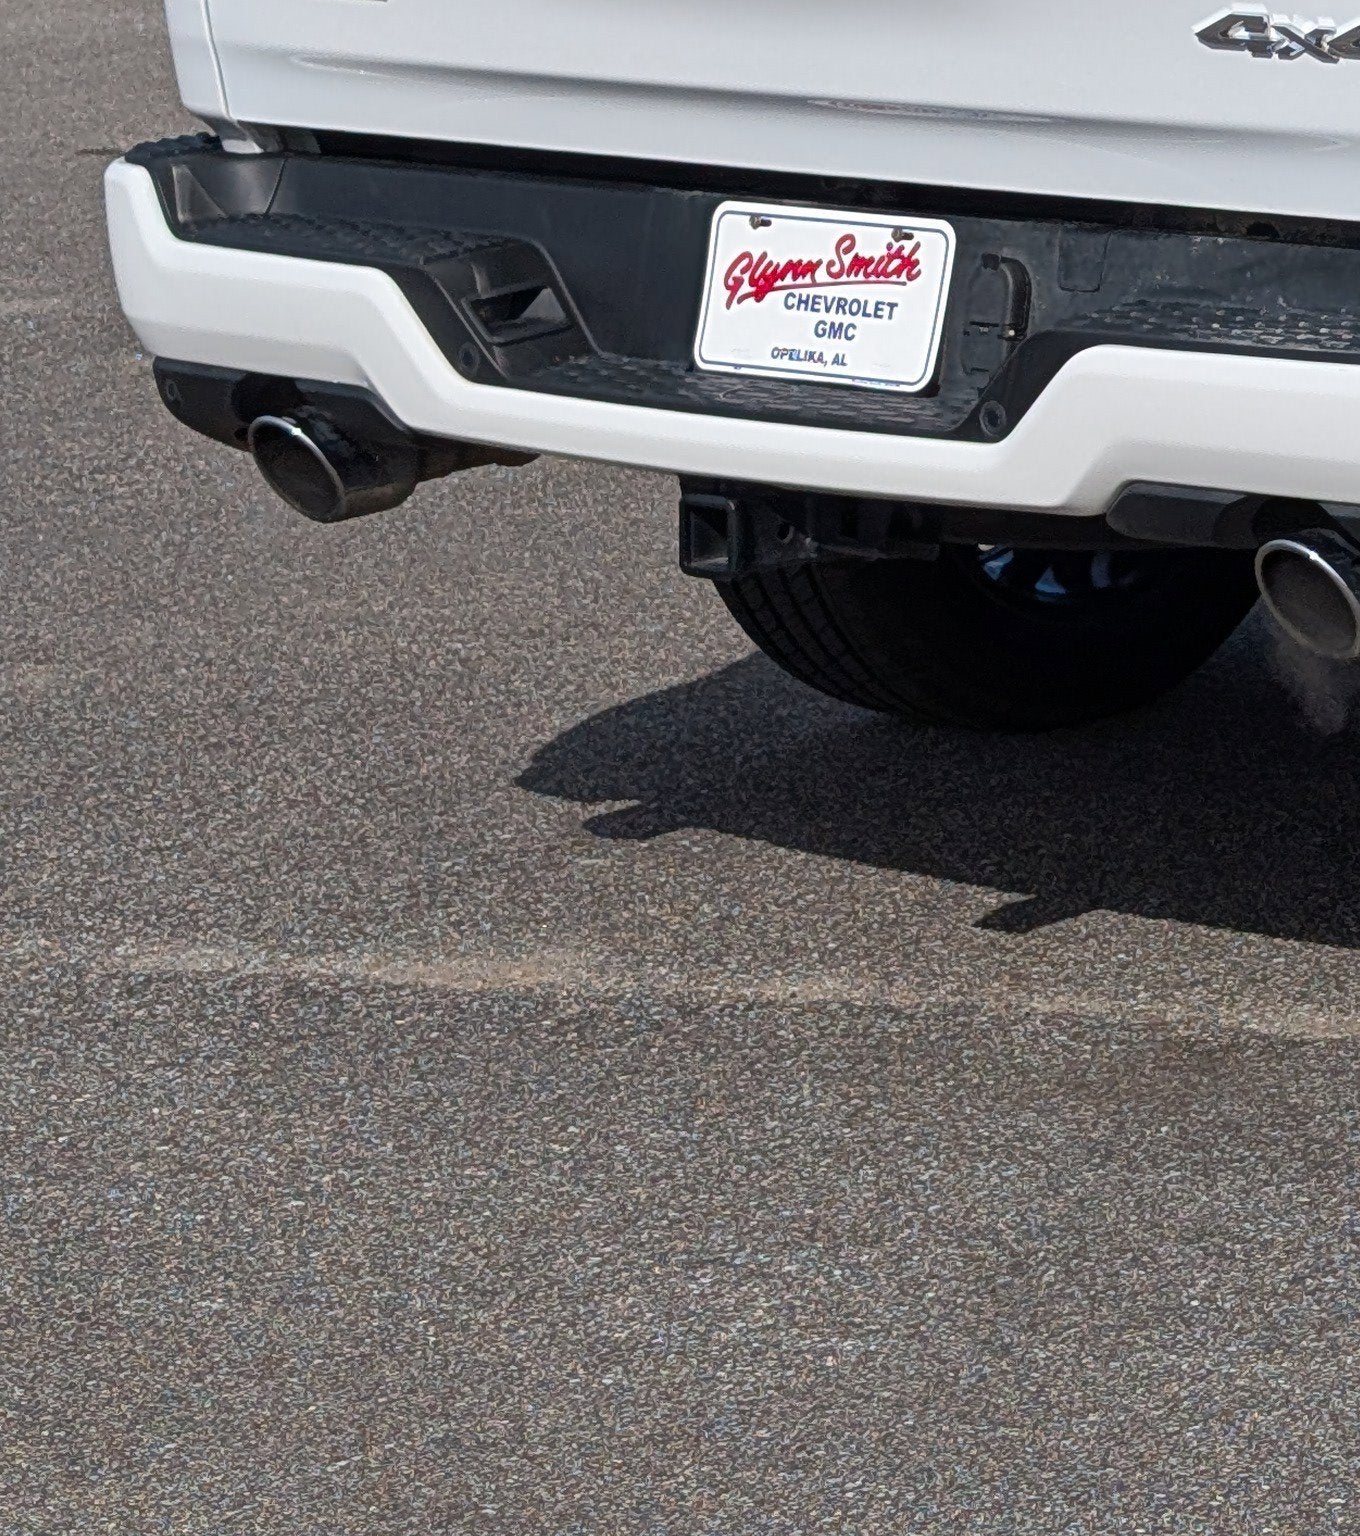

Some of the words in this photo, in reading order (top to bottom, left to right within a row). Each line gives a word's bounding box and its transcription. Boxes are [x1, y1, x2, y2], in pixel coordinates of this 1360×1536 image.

[723, 250, 823, 311] Glynn
[825, 233, 922, 282] Smith
[783, 291, 899, 321] CHEVROLET
[813, 320, 858, 341] GMC
[770, 346, 828, 367] OPELIKA,
[830, 352, 849, 367] AL
